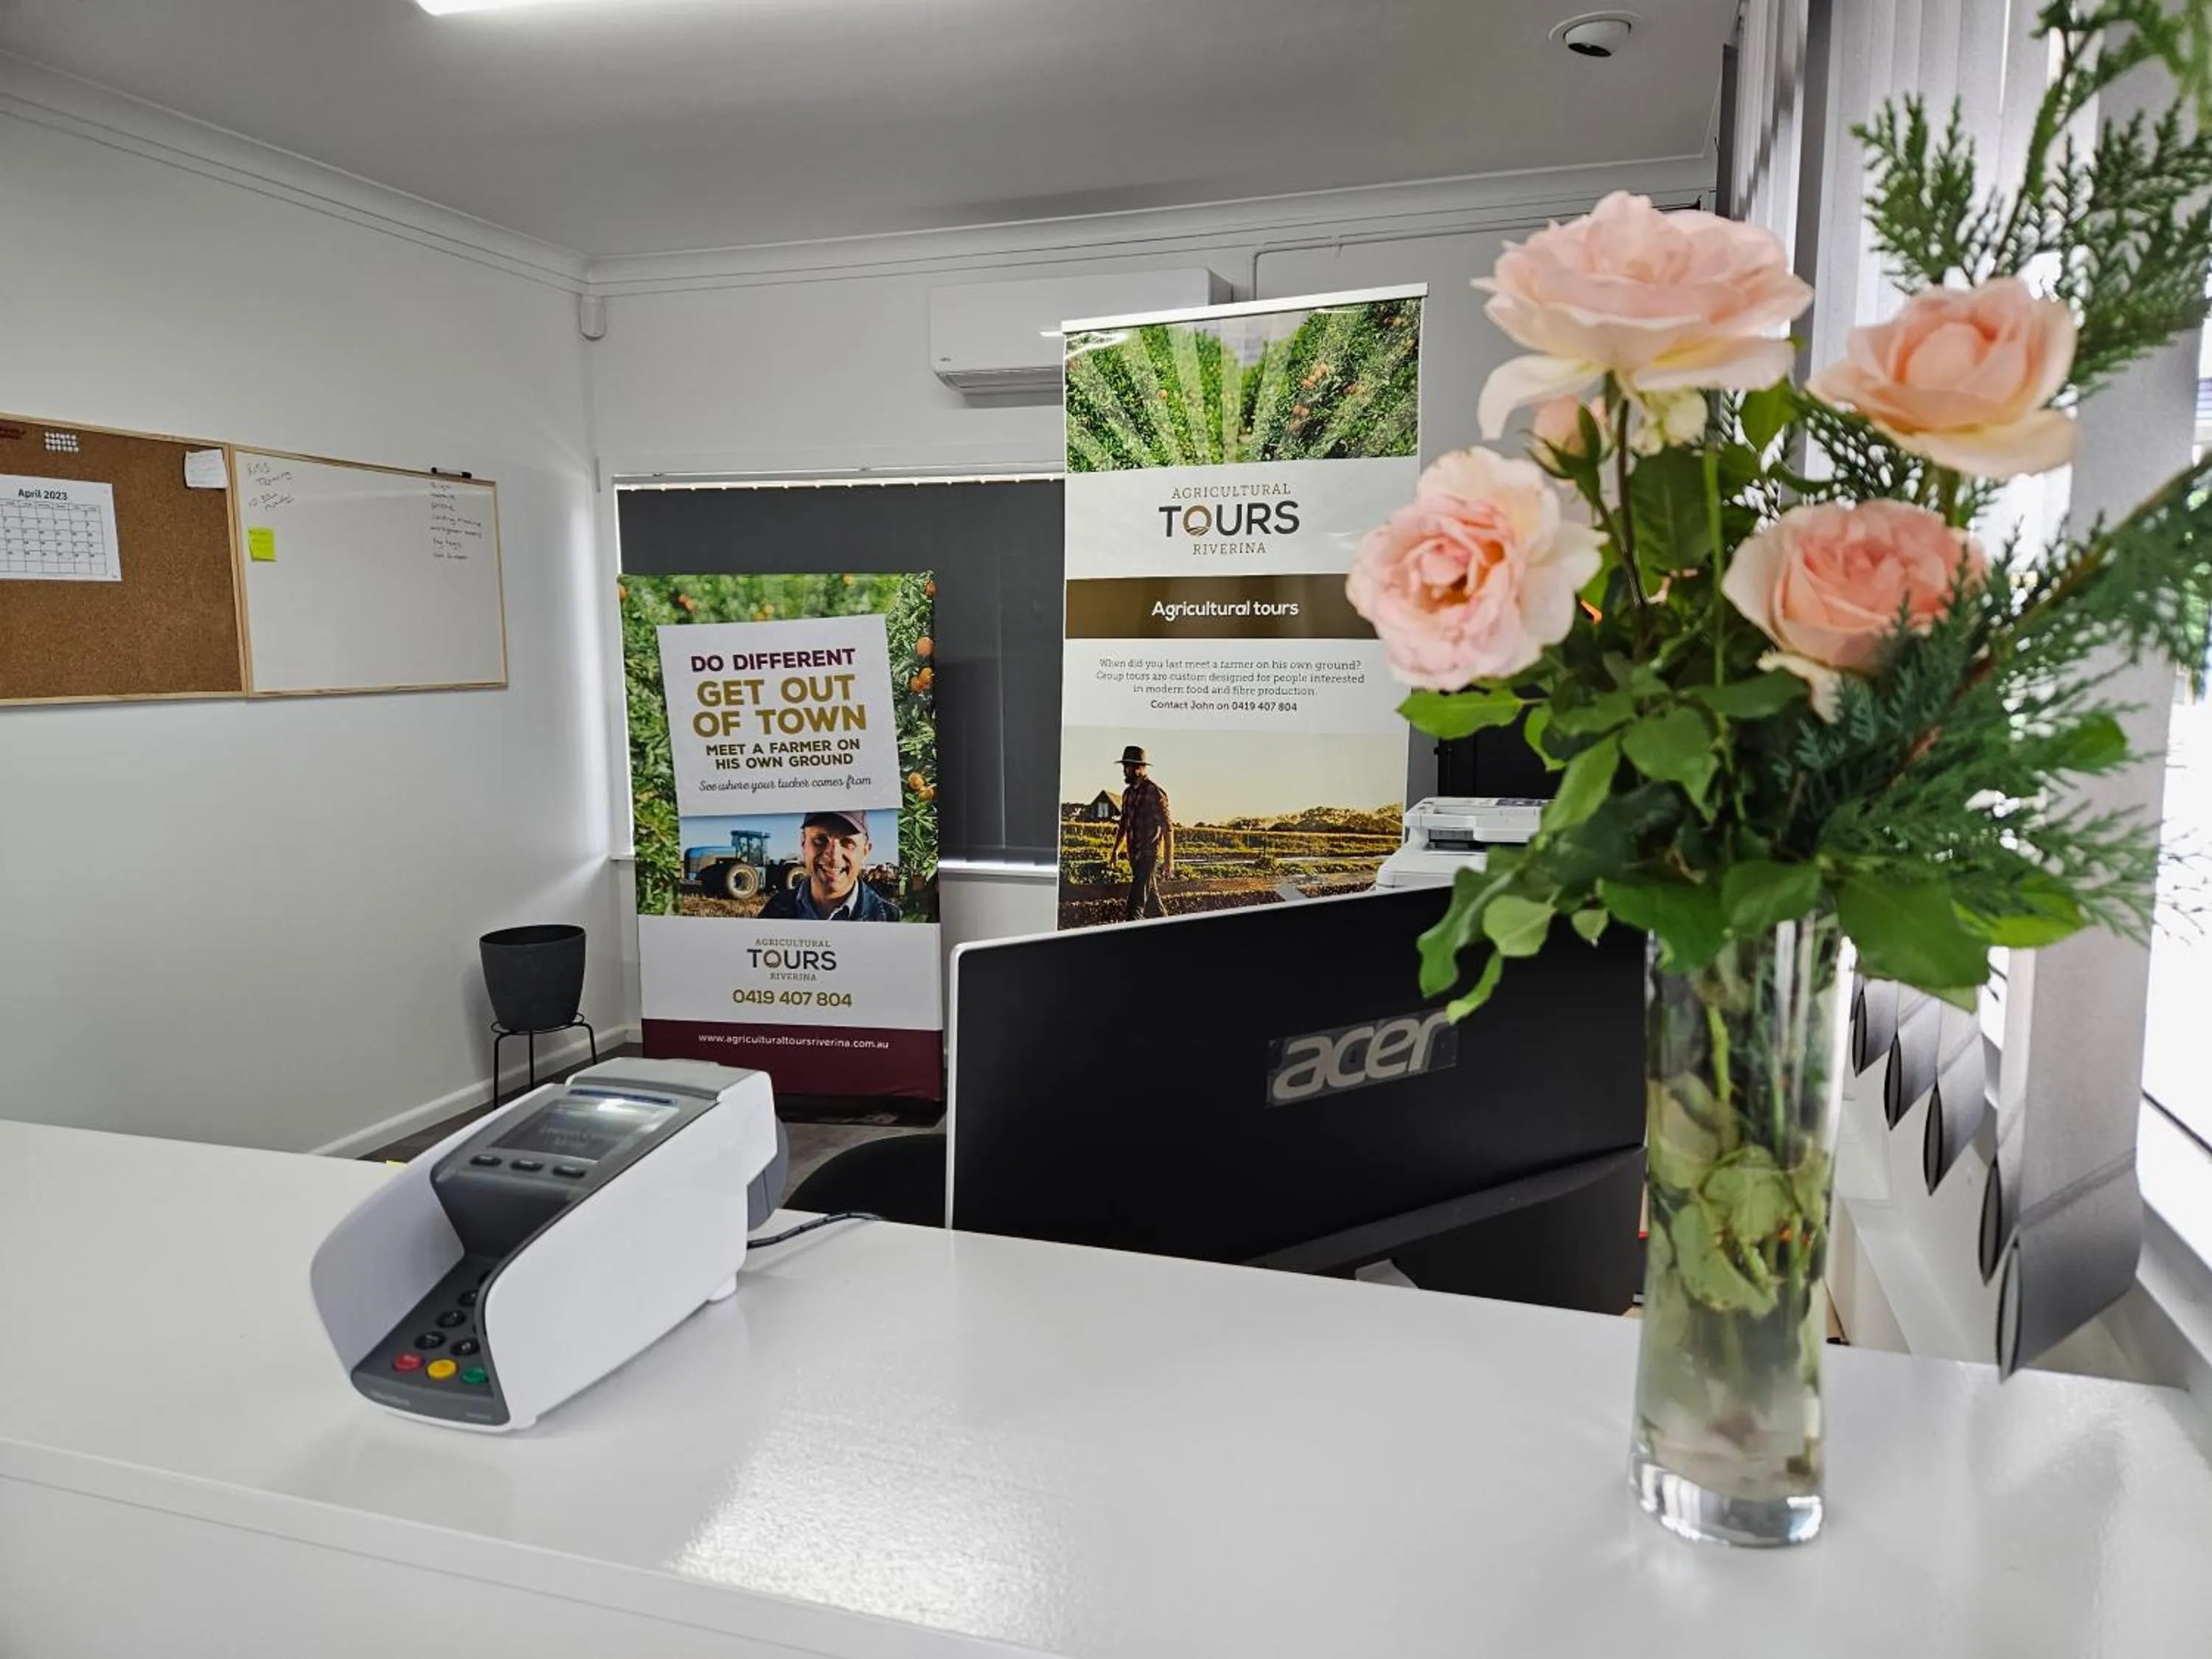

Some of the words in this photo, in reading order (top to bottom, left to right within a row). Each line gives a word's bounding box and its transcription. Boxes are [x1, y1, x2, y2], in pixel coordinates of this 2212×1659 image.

[18, 488, 41, 498] April
[44, 491, 68, 500] 2023
[1171, 484, 1291, 499] AGRICULTURAL
[1158, 501, 1299, 537] TOURS
[1192, 542, 1267, 555] RIVERINA
[1151, 600, 1251, 622] Agricultural
[1253, 601, 1299, 616] tours
[691, 655, 723, 672] DO
[732, 648, 855, 671] DIFFERENT
[1099, 658, 1126, 667] When
[1127, 659, 1143, 667] did
[1145, 661, 1163, 669] you
[1166, 659, 1183, 668] last
[1185, 661, 1210, 669] meet
[1220, 661, 1253, 669] farmer
[1272, 661, 1287, 669] his
[1315, 661, 1362, 671] ground?
[1096, 671, 1124, 681] Group
[1126, 672, 1151, 681] tours
[1169, 672, 1207, 681] custom
[1208, 672, 1254, 683] designed
[1256, 673, 1271, 682] for
[1273, 673, 1307, 684] people
[1310, 674, 1365, 684] interested
[697, 679, 765, 707] GET
[780, 674, 855, 703] OUT
[1133, 684, 1143, 692] in
[1145, 684, 1183, 694] modern
[1186, 685, 1208, 694] food
[1211, 686, 1231, 694] and
[1233, 686, 1256, 695] fibre
[1150, 700, 1188, 709] Contact
[1190, 700, 1214, 710] John
[1231, 701, 1256, 711] 0419
[1257, 701, 1276, 711] 407
[1278, 702, 1298, 712] 804
[693, 710, 741, 737] OF
[755, 704, 866, 735] TOWN
[706, 743, 745, 756] MEET
[752, 743, 764, 754] A
[769, 740, 831, 754] FARMER
[838, 739, 860, 751] ON
[715, 758, 740, 770] HIS
[745, 757, 782, 769] OWN
[789, 754, 854, 767] GROUND
[698, 780, 717, 792] See
[717, 779, 750, 790] where
[751, 779, 776, 794] your
[777, 776, 810, 789] tucker
[811, 778, 844, 788] comes
[845, 774, 872, 790] from
[755, 938, 831, 947] AGRICULTURAL
[747, 948, 838, 971] TOURS
[770, 972, 817, 981] RIVERINA
[732, 989, 775, 1005] 0419
[779, 990, 813, 1006] 407
[816, 992, 852, 1008] 804
[698, 1032, 890, 1049] www.agriculturaltoursriverina.com.au
[1272, 1010, 1447, 1099] acer
